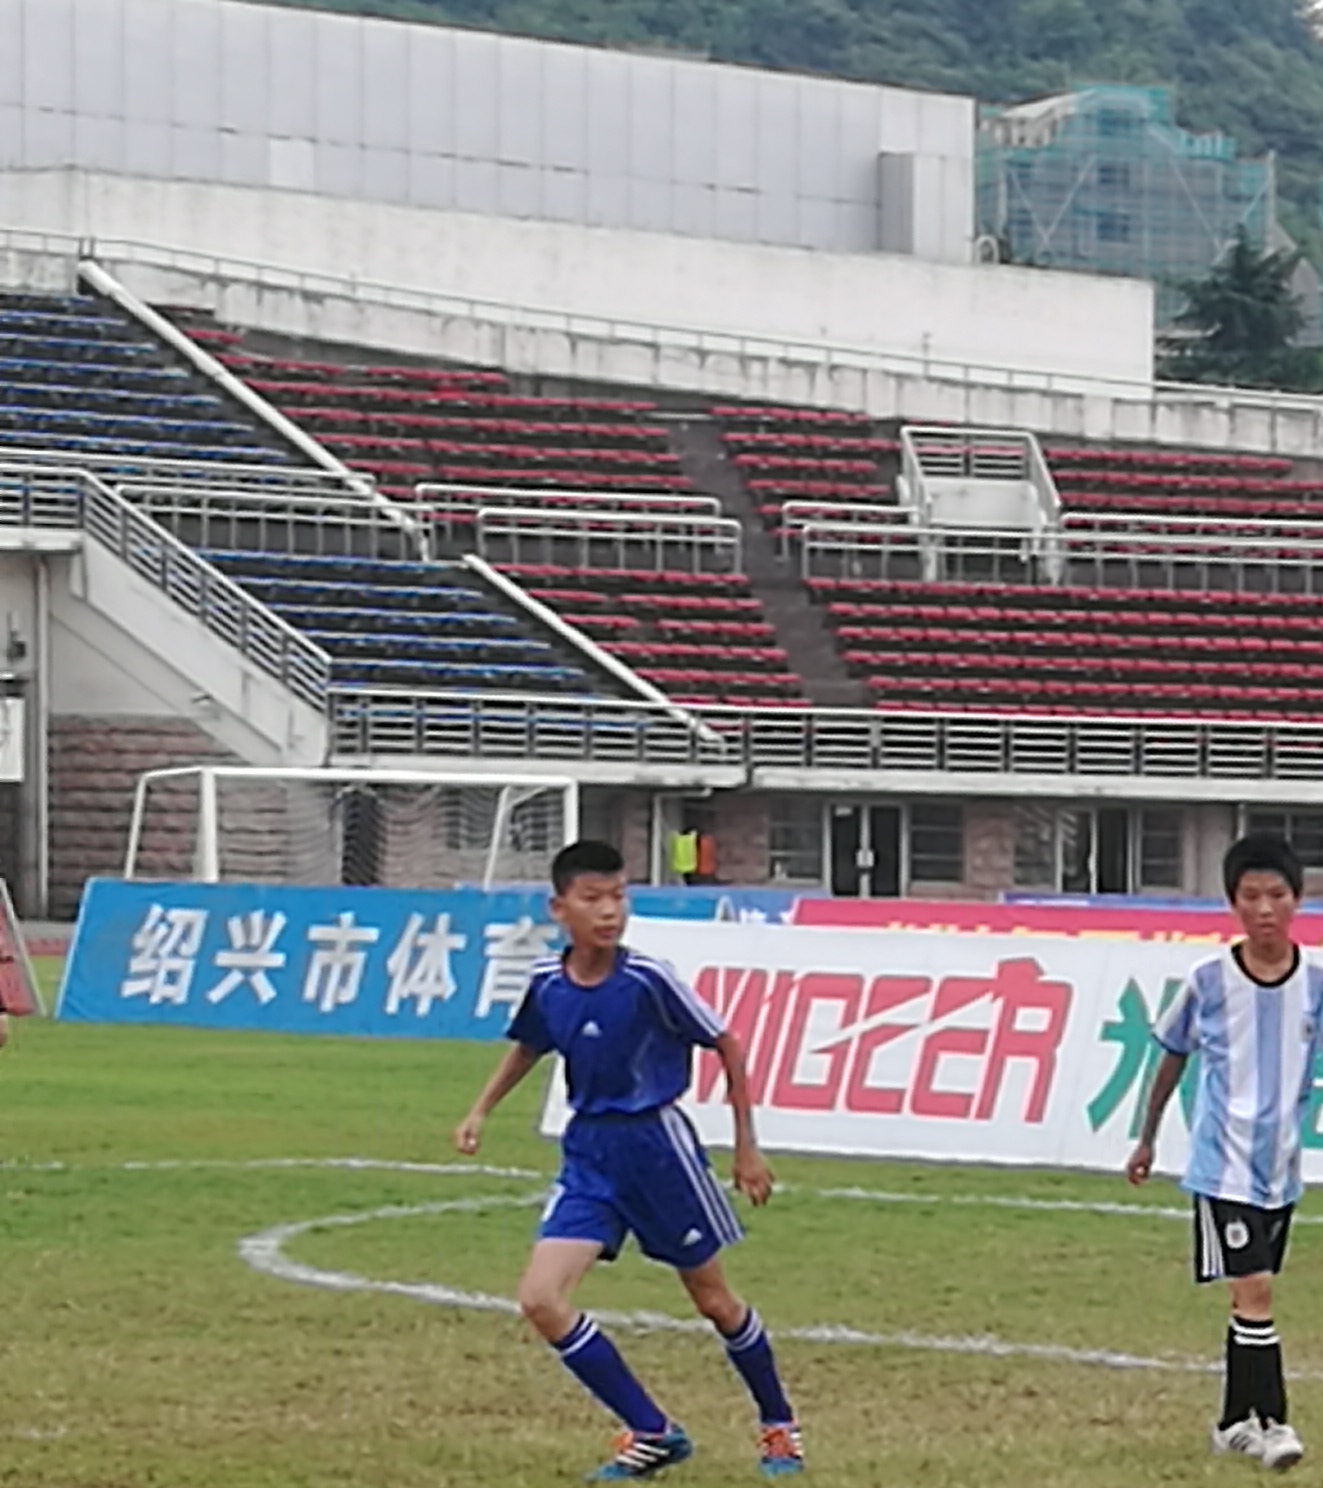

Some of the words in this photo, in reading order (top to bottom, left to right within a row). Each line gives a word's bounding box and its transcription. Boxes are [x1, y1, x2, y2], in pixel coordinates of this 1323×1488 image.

[121, 903, 560, 1019] 绍兴市体育
